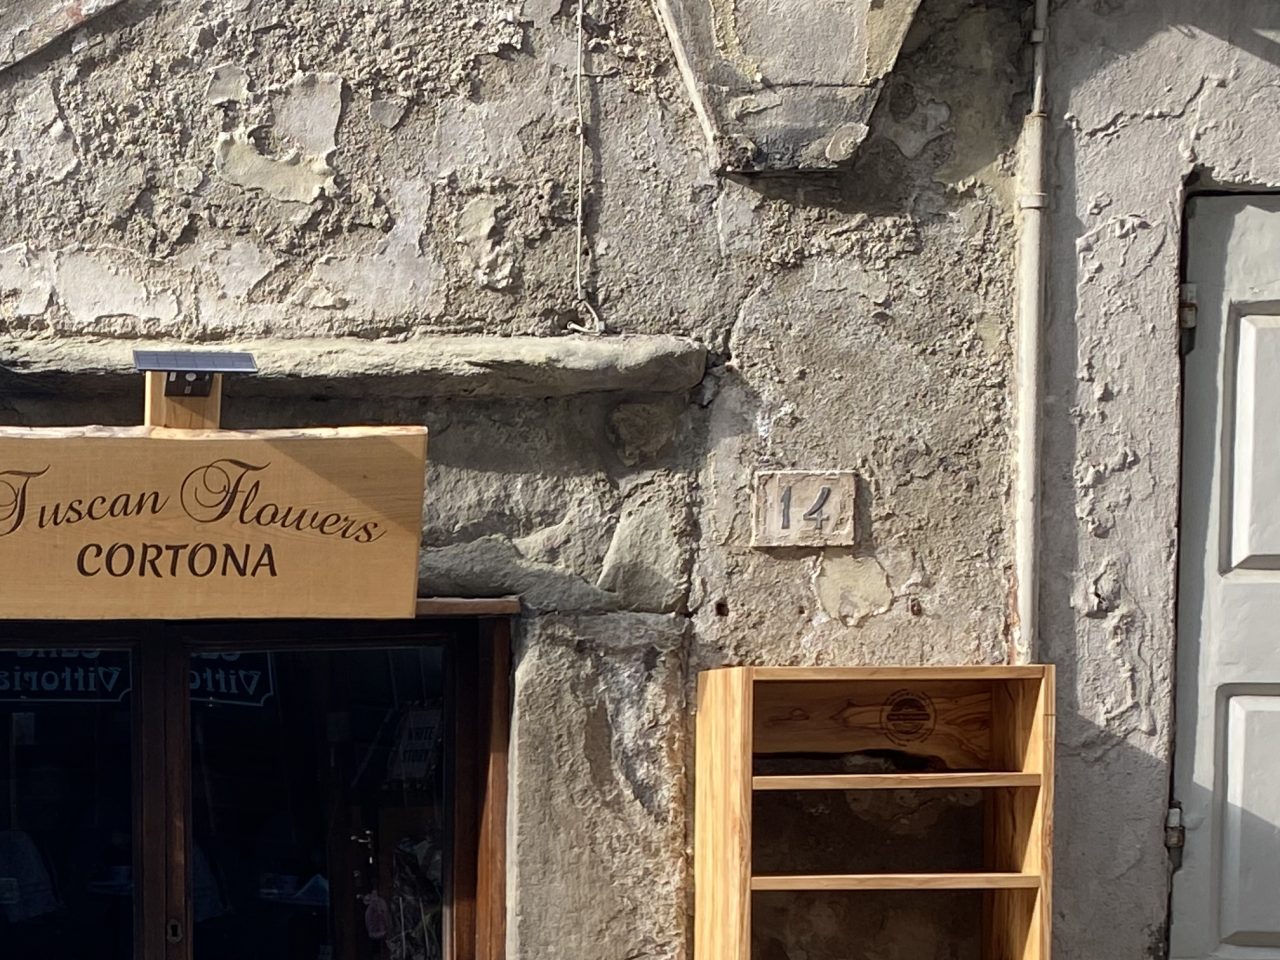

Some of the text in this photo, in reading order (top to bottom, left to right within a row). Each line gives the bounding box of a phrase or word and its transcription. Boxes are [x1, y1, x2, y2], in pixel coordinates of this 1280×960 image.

[180, 458, 387, 543] Flowers
[780, 486, 831, 529] 14
[77, 542, 278, 579] CORTONA
